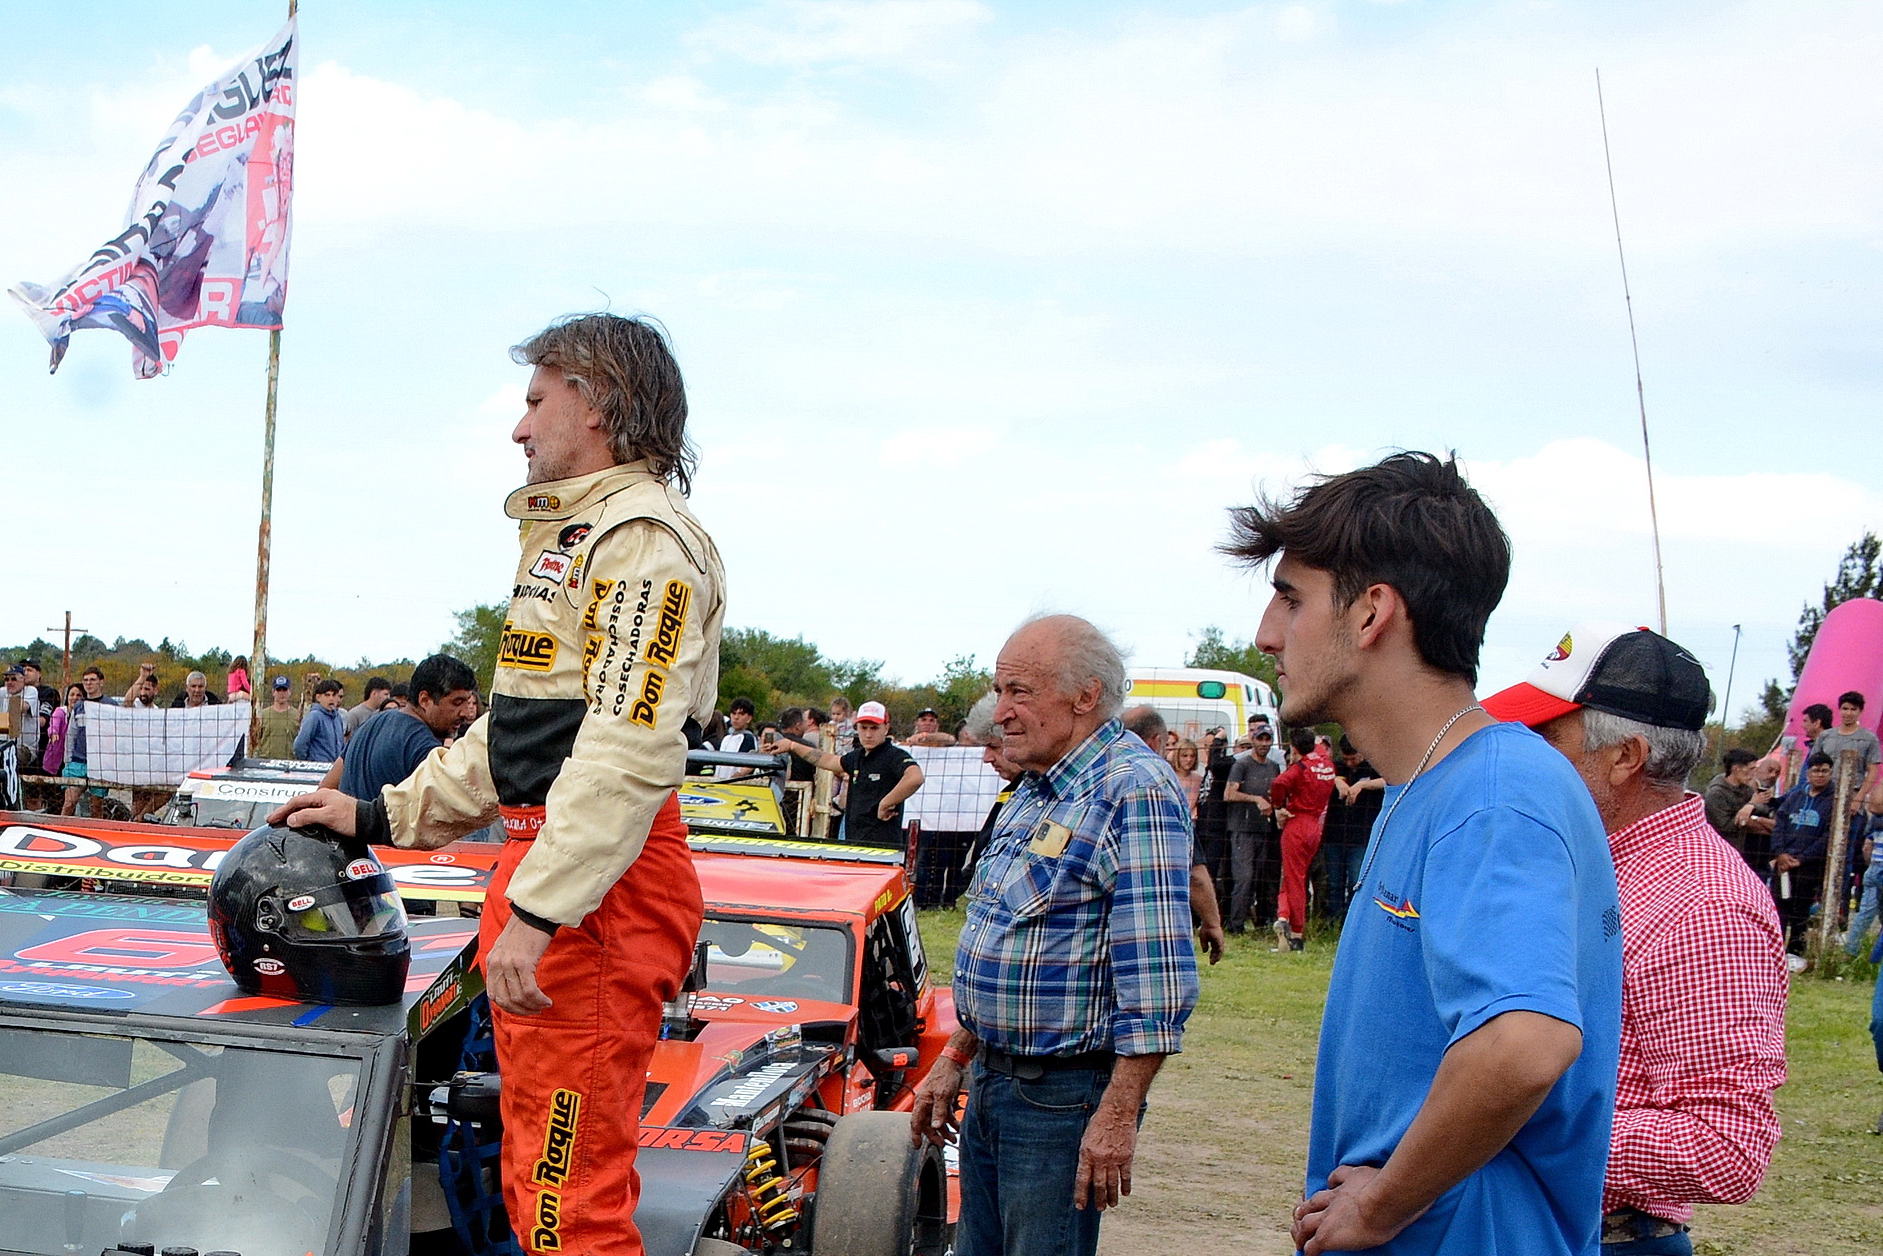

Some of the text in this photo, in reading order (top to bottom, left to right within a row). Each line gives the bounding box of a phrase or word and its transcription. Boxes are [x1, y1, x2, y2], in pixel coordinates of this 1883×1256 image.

[613, 579, 652, 716] COSECHADORAS
[630, 580, 690, 726] Don Roque
[218, 783, 309, 798] Construc
[352, 864, 377, 876] BELL
[291, 899, 312, 908] BELL
[259, 962, 279, 971] RS7
[534, 1090, 580, 1251] Don Roque
